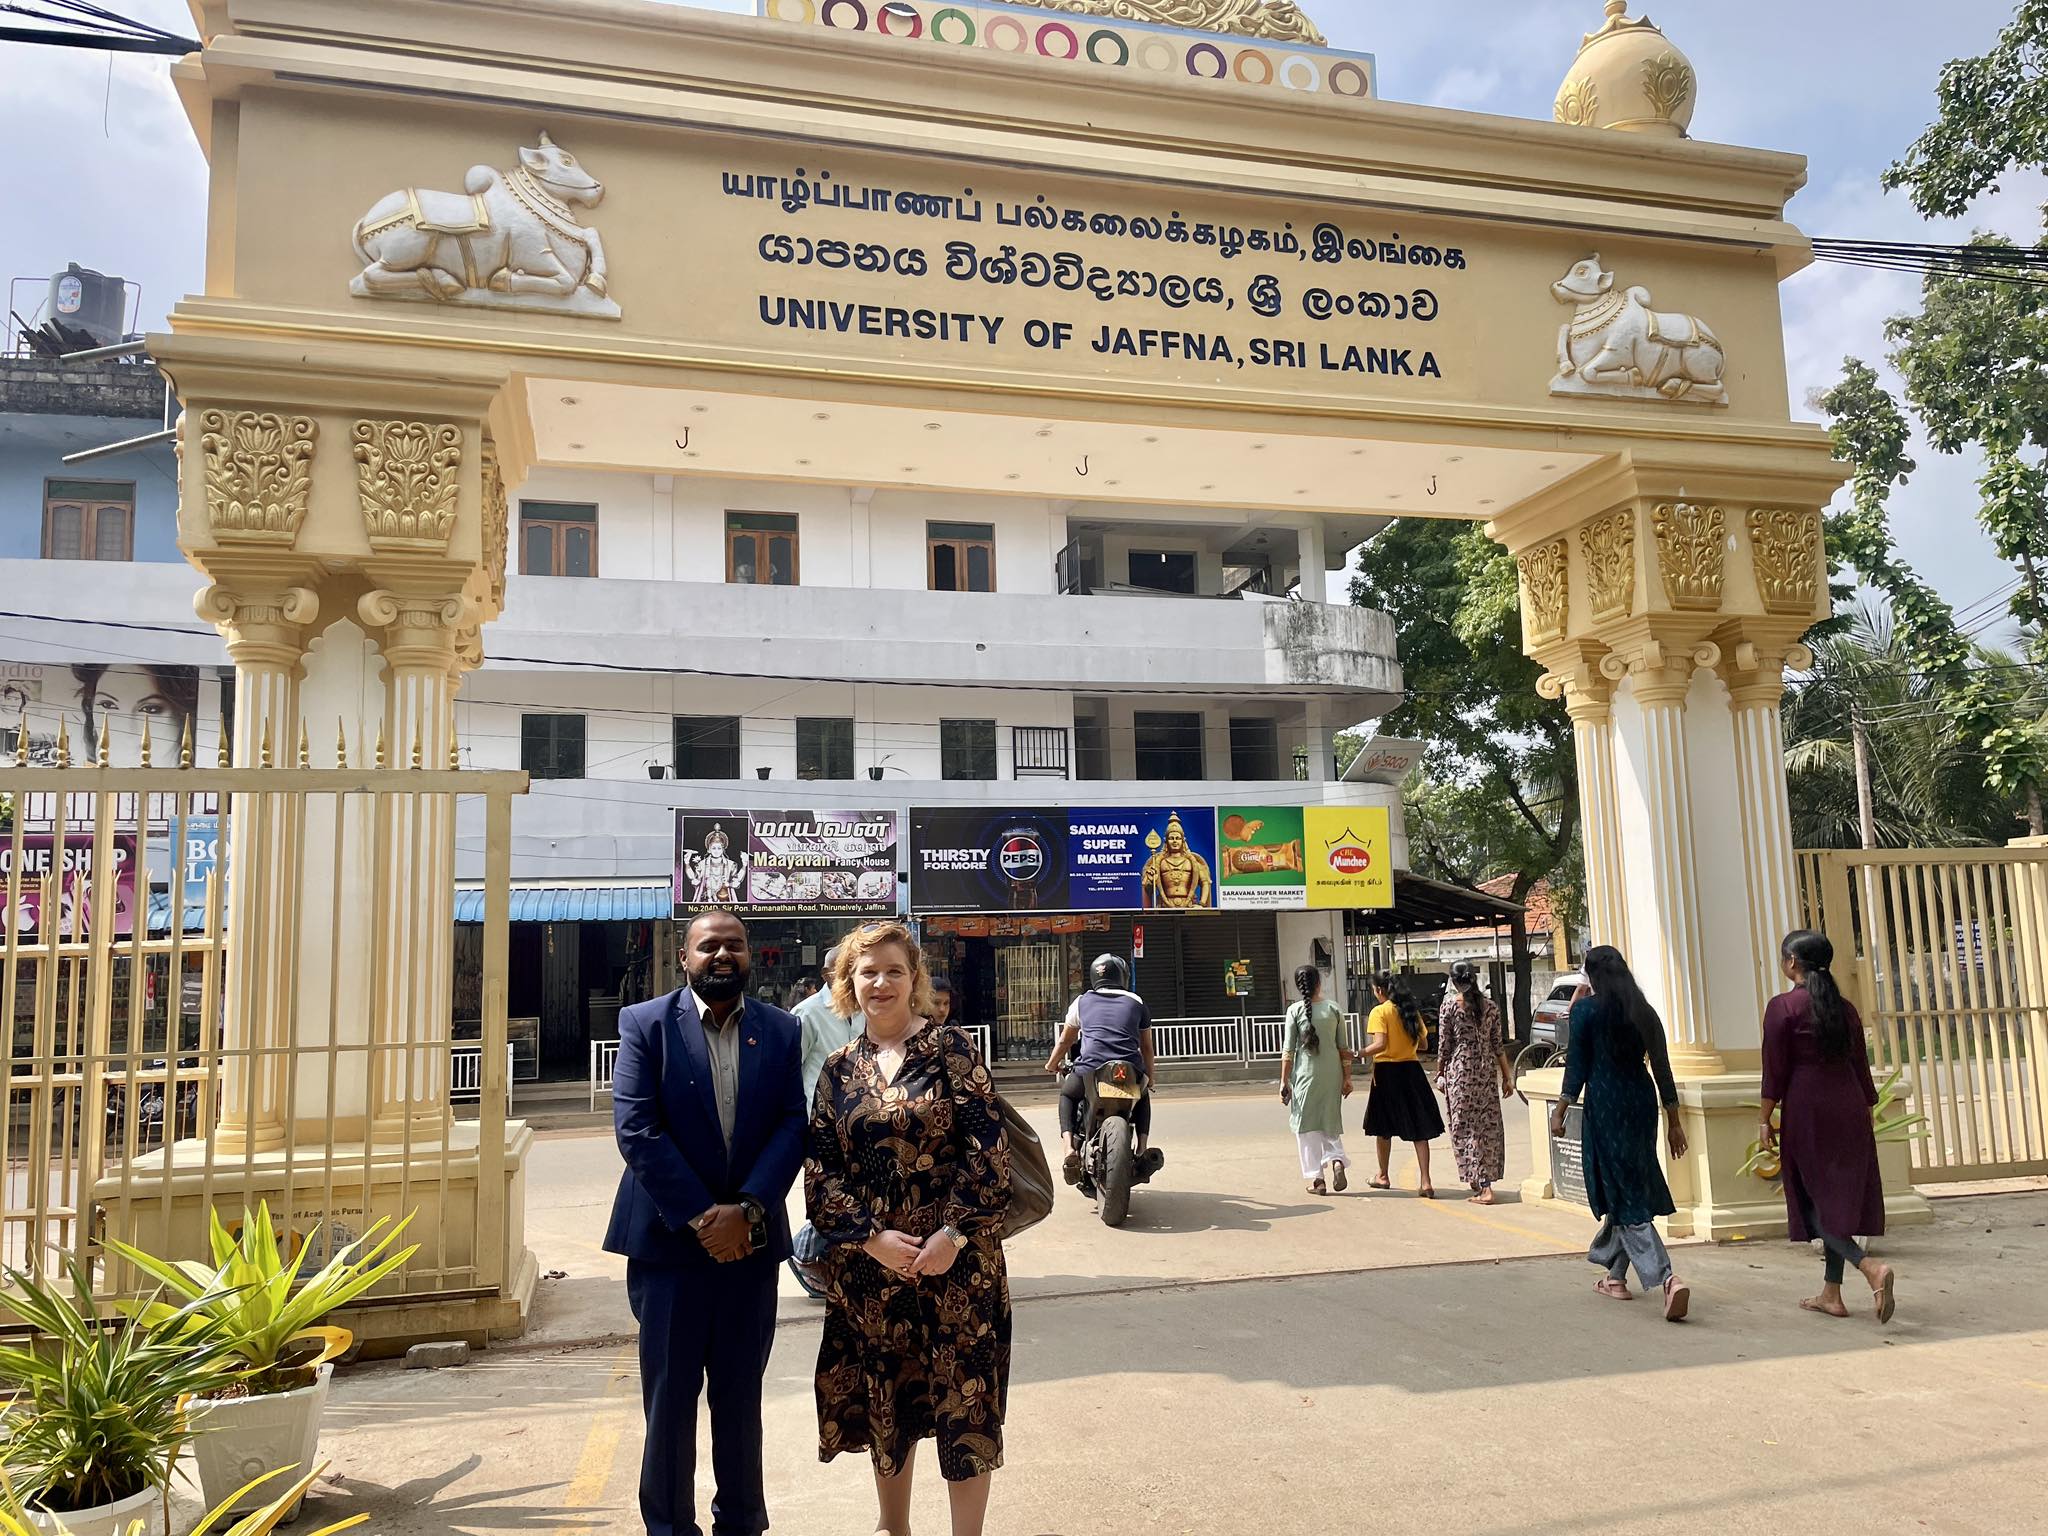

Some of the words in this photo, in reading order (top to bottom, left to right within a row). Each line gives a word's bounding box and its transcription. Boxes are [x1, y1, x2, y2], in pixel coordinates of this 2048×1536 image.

[722, 168, 983, 222] யாழ்ப்பாணப்
[758, 233, 928, 277] යාපනය
[1302, 287, 1439, 322] ලංකාව
[759, 295, 1005, 345] UNIVERSITY
[1023, 319, 1073, 350] OF
[1320, 343, 1442, 379] LANKA
[753, 815, 890, 838] மாயவன்
[1069, 824, 1139, 836] SARAVANA
[1083, 838, 1126, 850] SUPER
[62, 848, 127, 872] SHP
[753, 852, 830, 869] Maayavan
[835, 857, 861, 868] Fancy
[863, 857, 890, 867] House
[920, 848, 990, 862] THIRSTY
[1003, 853, 1040, 865] PEPSI
[1077, 853, 1133, 865] MARKET
[1332, 855, 1368, 868] Munchee
[923, 861, 949, 870] FOR
[951, 861, 987, 870] MORE
[752, 904, 796, 912] Ramanathan
[798, 904, 818, 912] Road,
[820, 904, 864, 912] Thirunelvely,
